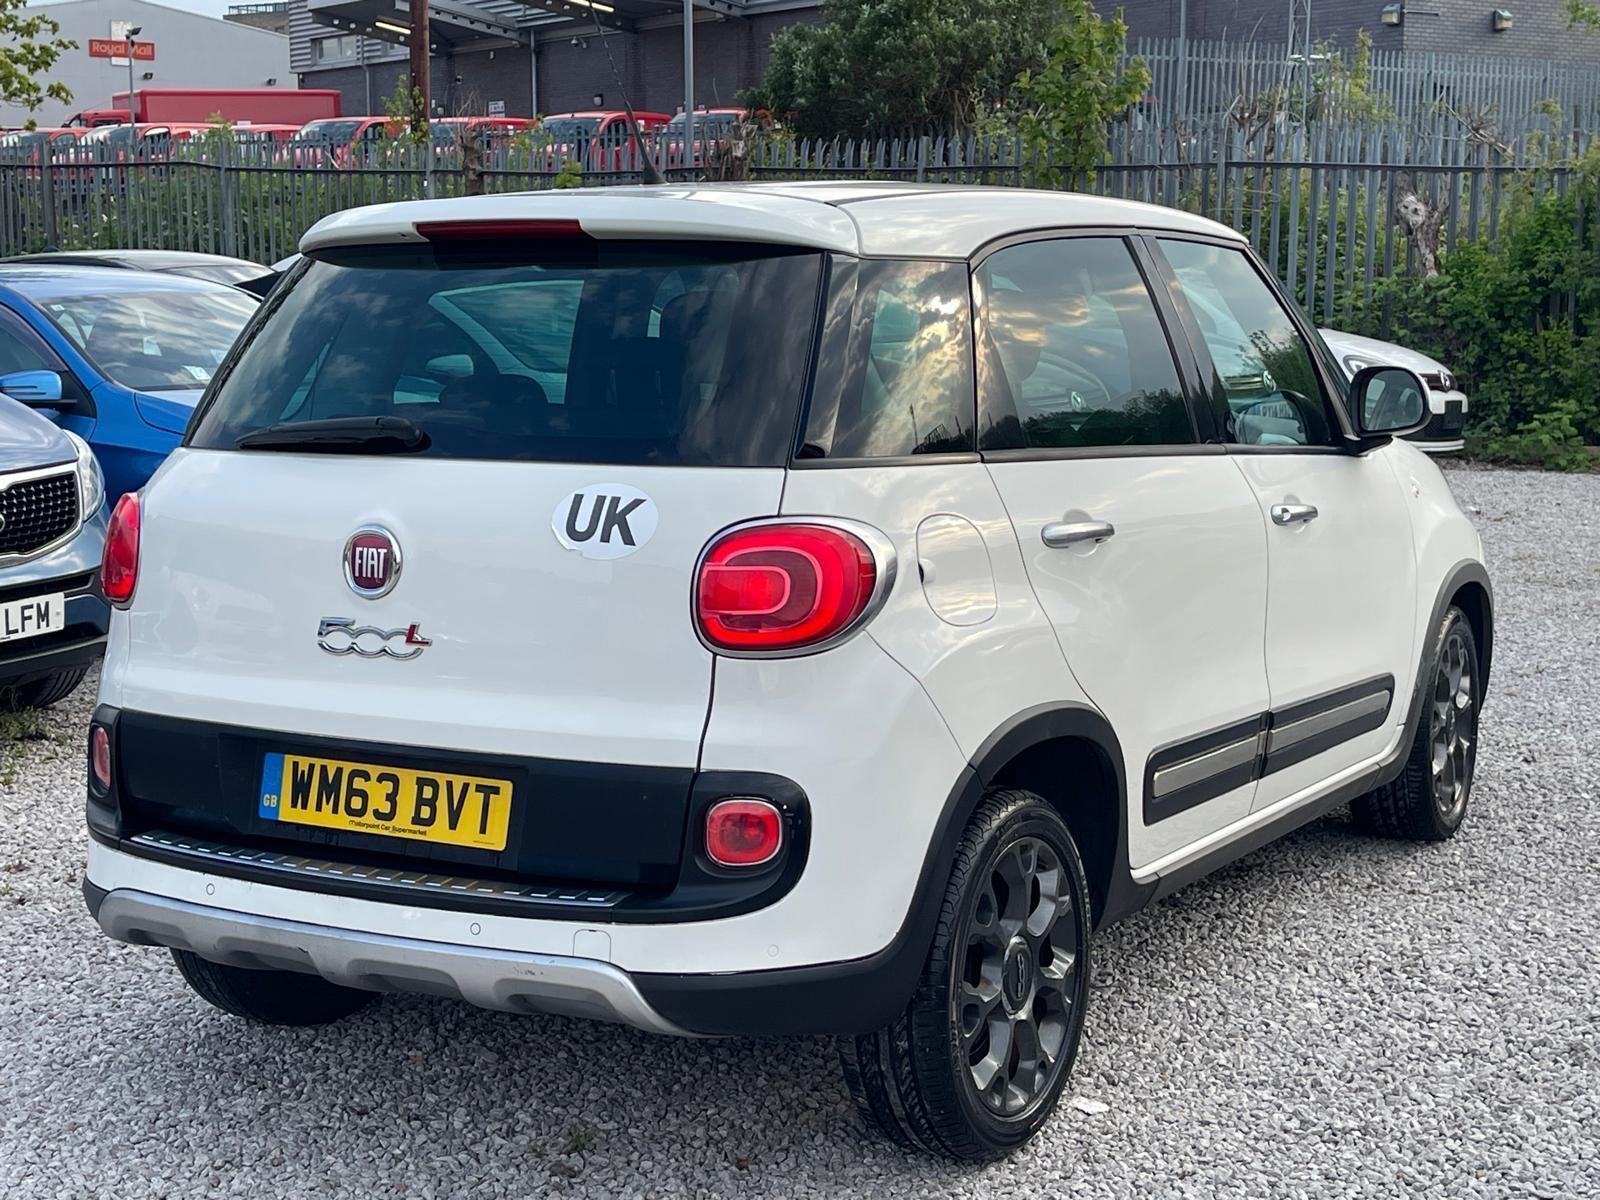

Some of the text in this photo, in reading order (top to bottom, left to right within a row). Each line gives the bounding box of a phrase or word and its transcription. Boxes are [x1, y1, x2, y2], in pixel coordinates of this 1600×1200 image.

[92, 42, 125, 55] Royal
[566, 493, 647, 546] UK
[355, 546, 387, 578] FIAT
[5, 600, 50, 635] LFM
[317, 616, 433, 661] 500L
[263, 794, 278, 807] GB
[290, 760, 501, 835] WM63 BVT
